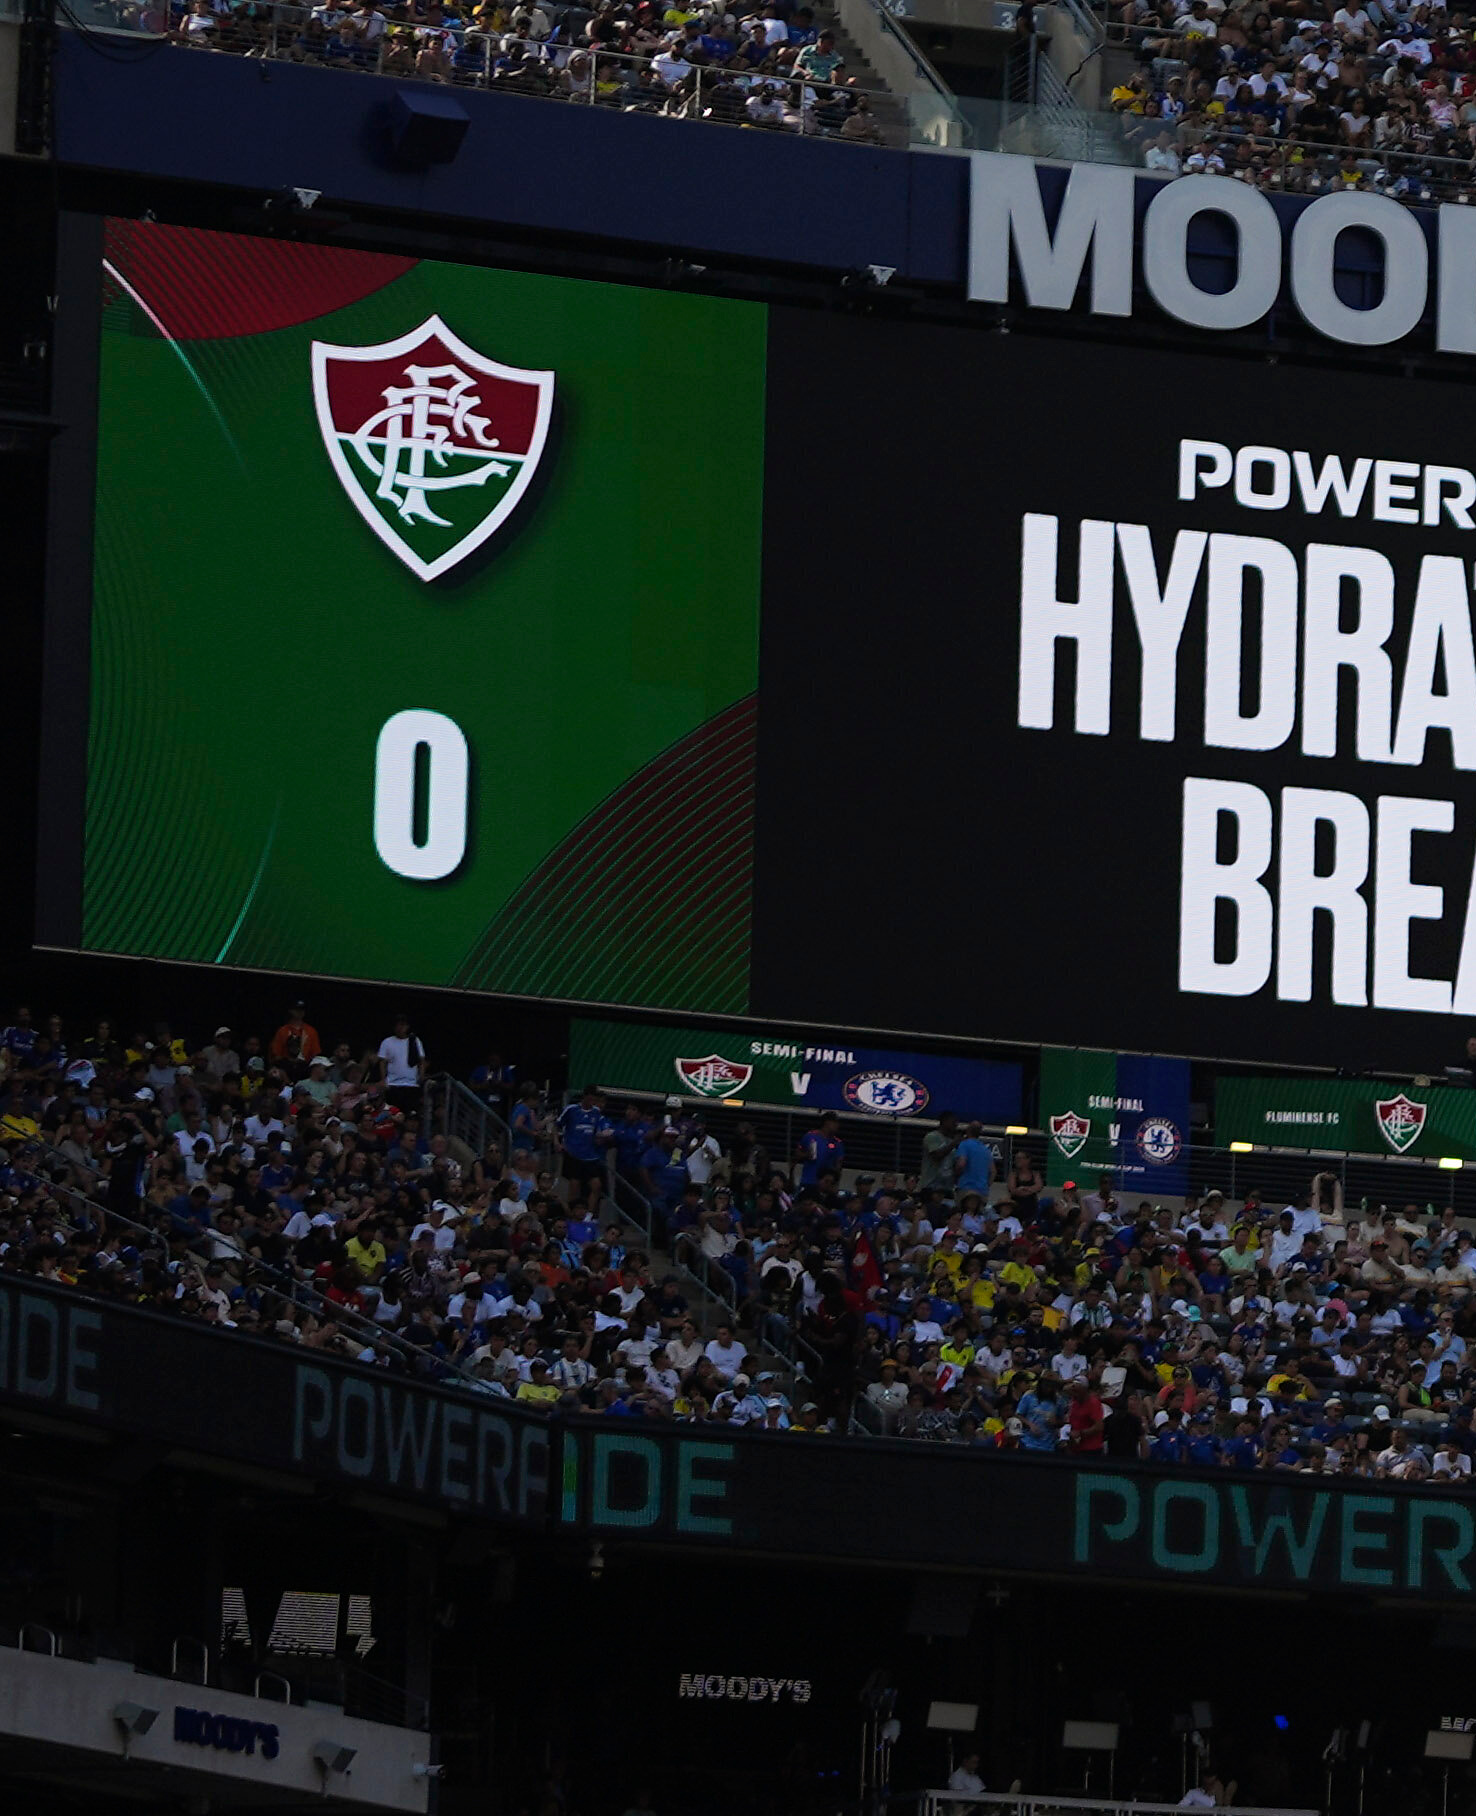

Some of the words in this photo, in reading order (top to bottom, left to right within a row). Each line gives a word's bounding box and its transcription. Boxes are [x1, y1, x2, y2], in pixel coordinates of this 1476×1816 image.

[374, 709, 468, 880] 0
[750, 1041, 857, 1065] SEMI-FINAL
[790, 1071, 811, 1095] V
[1088, 1094, 1144, 1112] SEMI-FINAL
[1327, 1112, 1340, 1125] FC
[1108, 1122, 1121, 1147] V
[679, 1673, 812, 1704] MOODY'S
